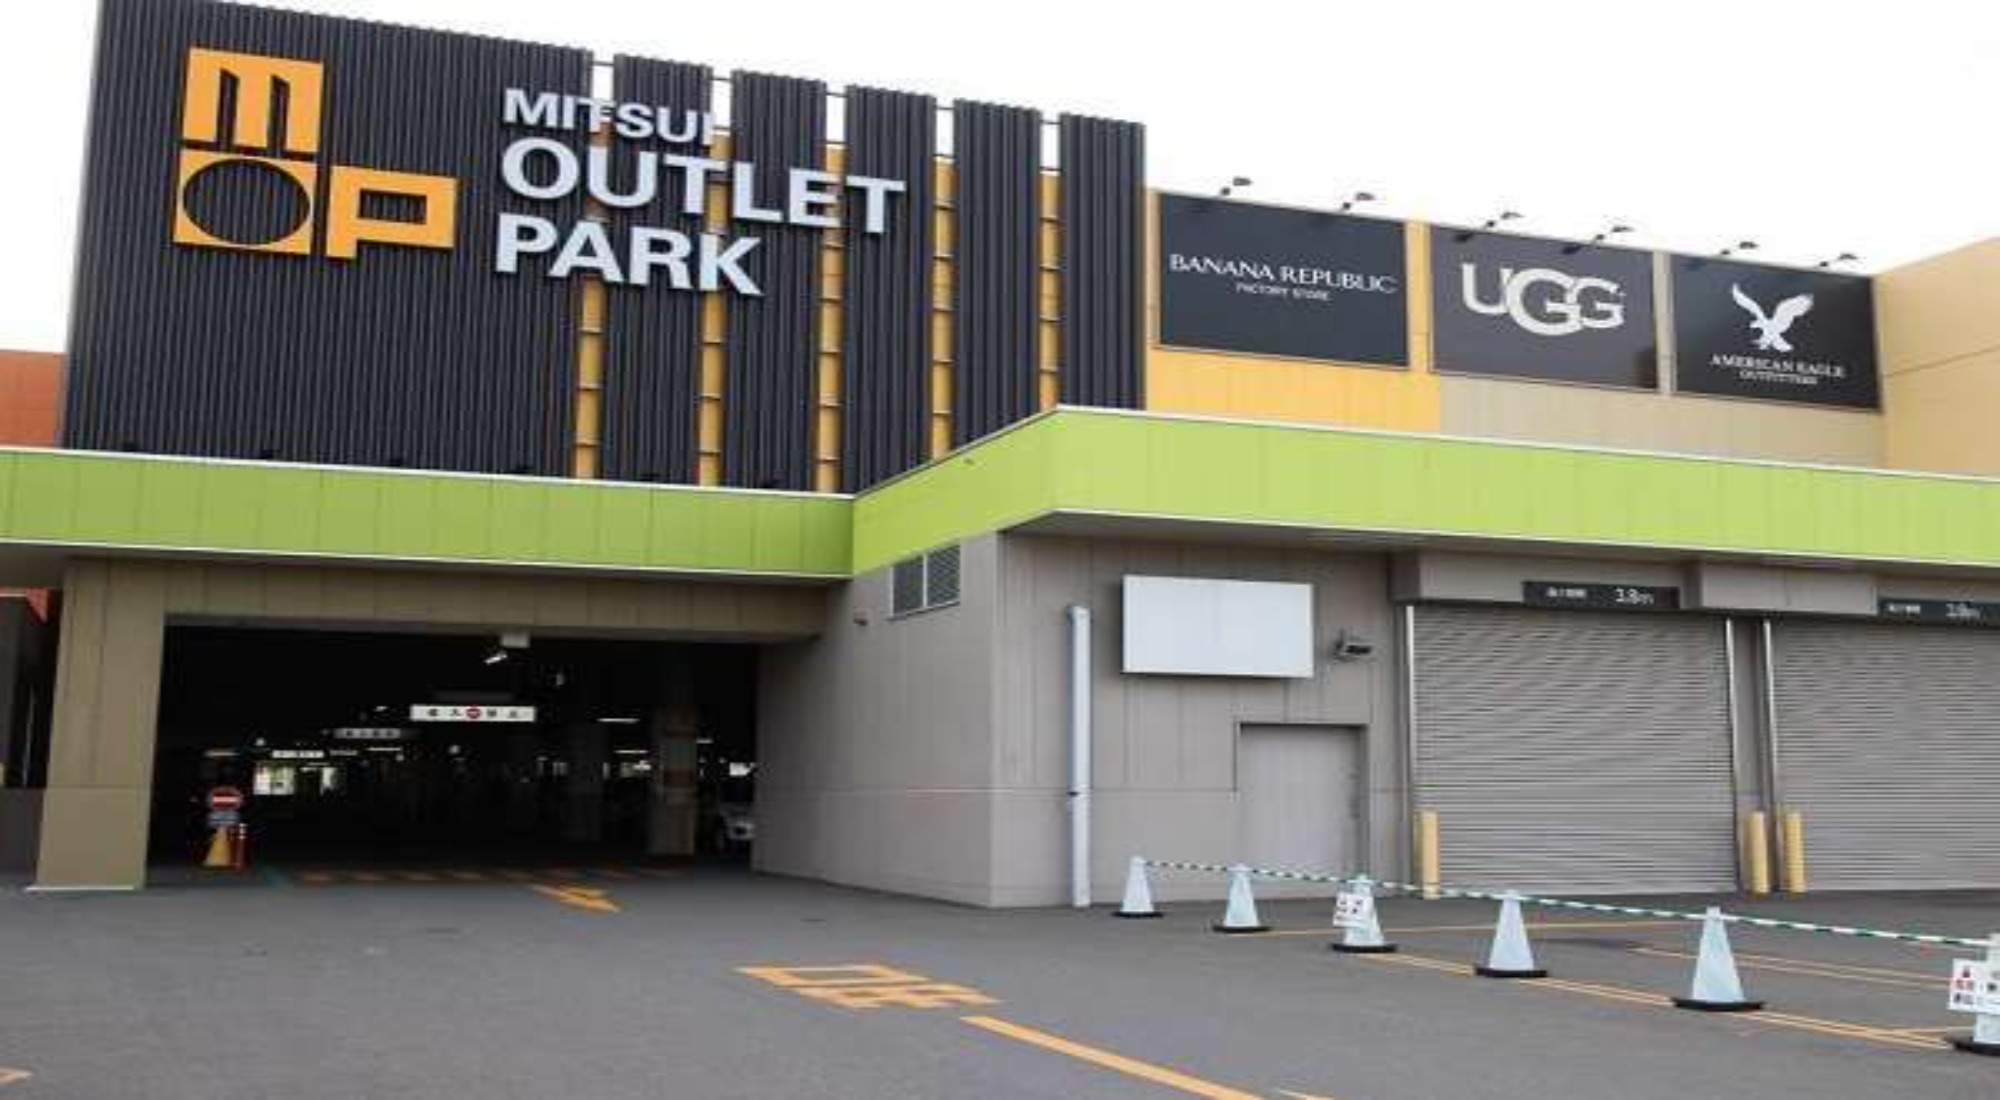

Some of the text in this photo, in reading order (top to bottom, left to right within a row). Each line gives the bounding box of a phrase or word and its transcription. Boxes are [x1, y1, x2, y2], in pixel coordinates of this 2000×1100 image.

[503, 87, 716, 146] MITSUI
[501, 136, 905, 234] OUTLET
[495, 211, 763, 297] PARK
[1168, 253, 1398, 294] BANANA REPUBLIC
[1461, 262, 1626, 336] UGG
[1709, 353, 1846, 379] AMERICAN EAGLE
